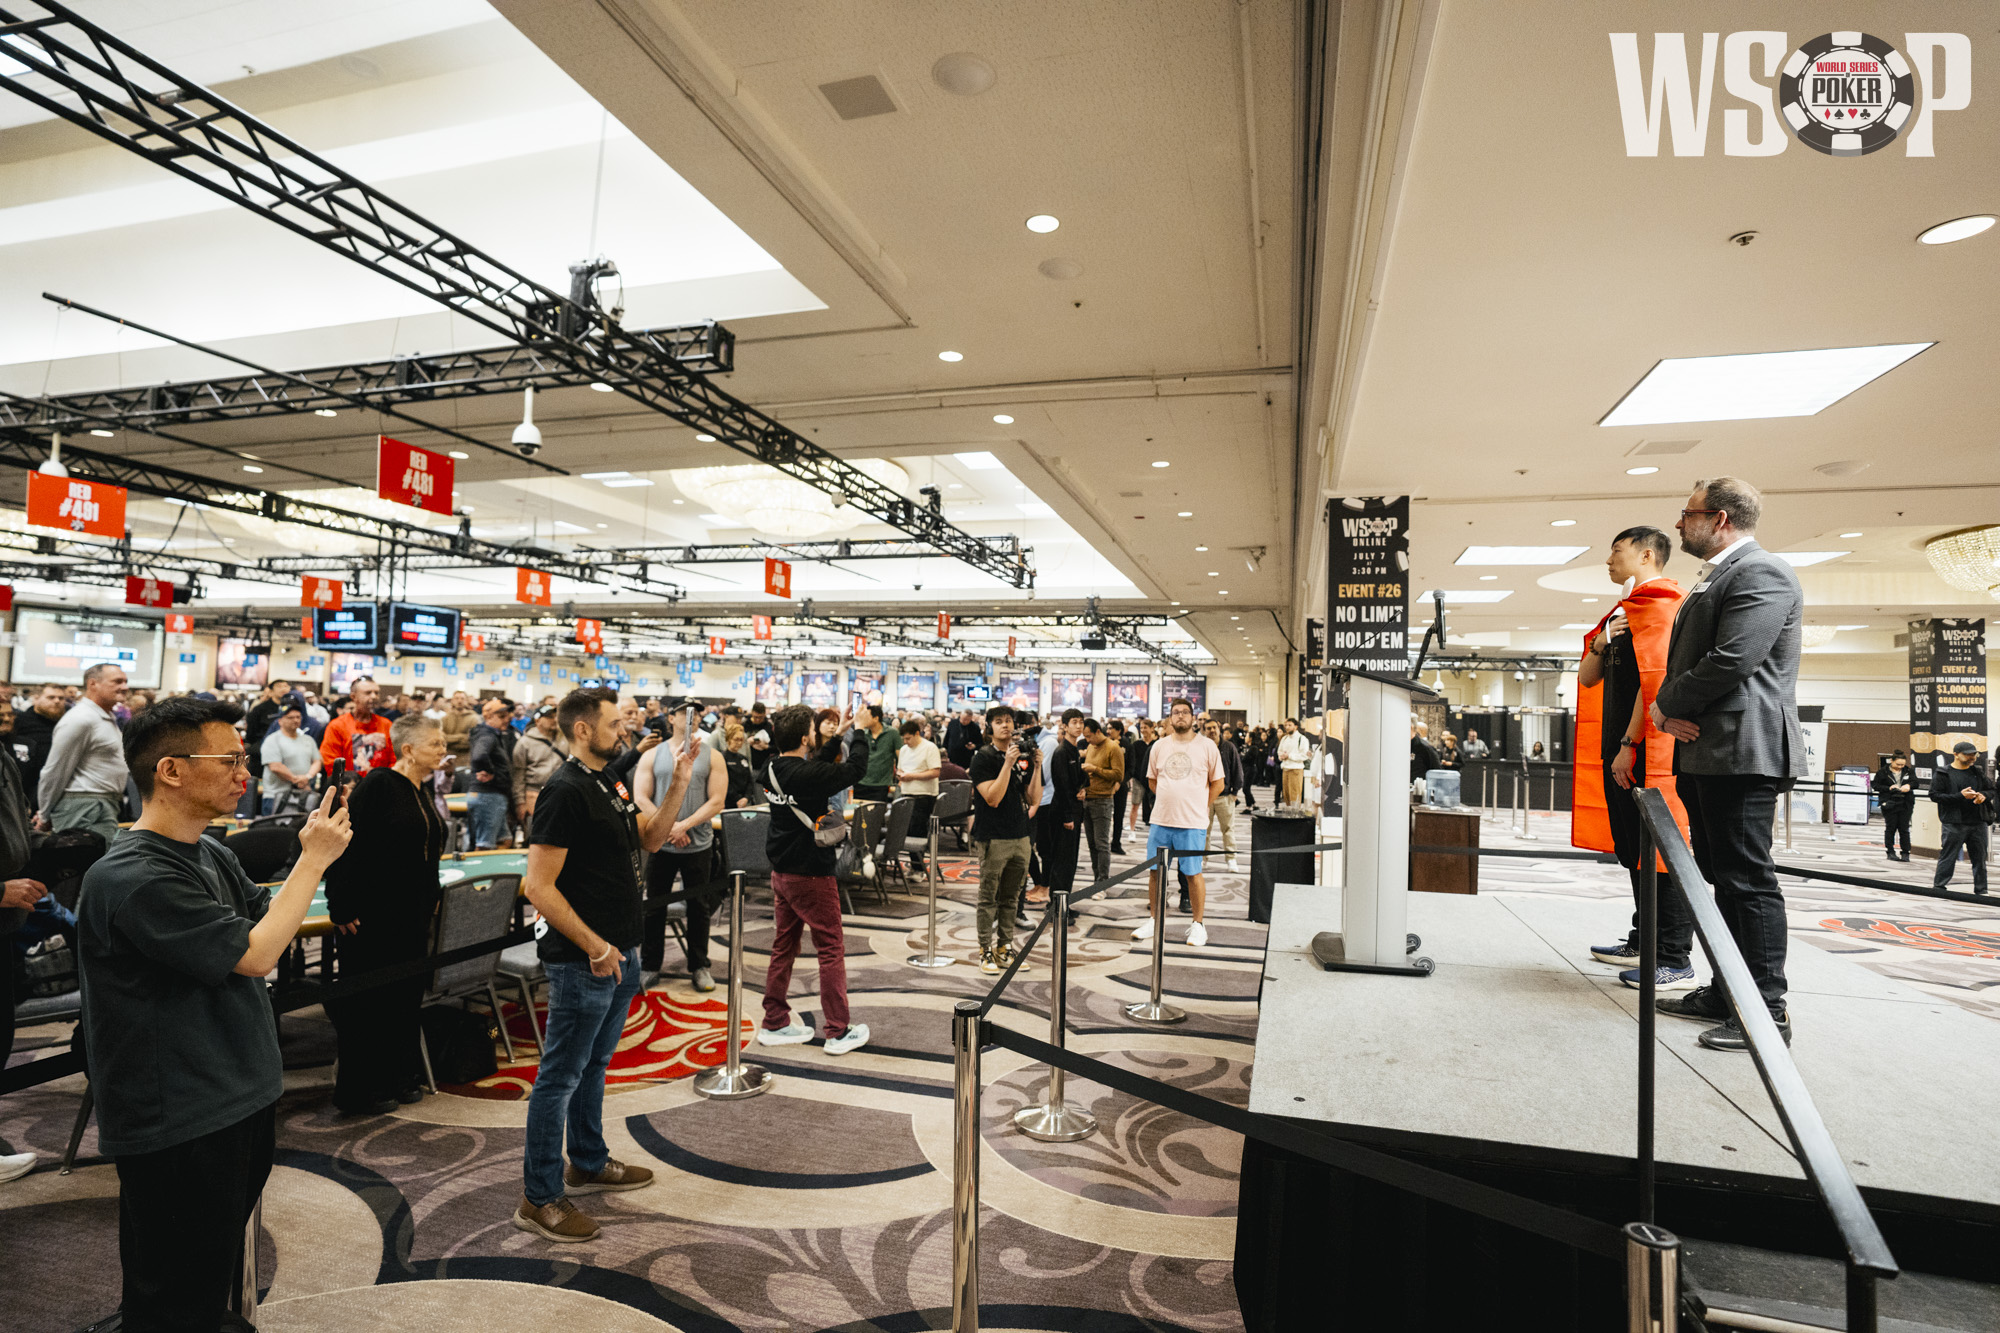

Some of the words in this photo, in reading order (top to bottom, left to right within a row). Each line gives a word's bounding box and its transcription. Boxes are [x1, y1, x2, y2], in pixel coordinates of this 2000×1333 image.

[410, 449, 428, 471] RED
[402, 467, 434, 496] #481
[68, 481, 92, 501] RED
[1342, 517, 1398, 538] WSOP
[1352, 537, 1387, 547] ONLINE
[1353, 552, 1375, 560] JULY
[1380, 552, 1386, 560] 7
[1352, 567, 1372, 575] 3:30
[1375, 567, 1387, 575] PM
[1338, 583, 1376, 598] EVENT
[1377, 583, 1402, 598] #26
[1336, 605, 1357, 623] NO
[1361, 605, 1404, 623] LIMIT
[1335, 631, 1404, 649] HOLD'EM
[1942, 629, 1979, 641] WSOP
[1942, 666, 1966, 674] EVENT
[1967, 665, 1978, 674] #2
[1915, 684, 1929, 693] CRAZY
[1936, 684, 1986, 695] $1,000,000
[1915, 694, 1930, 713] 8'S
